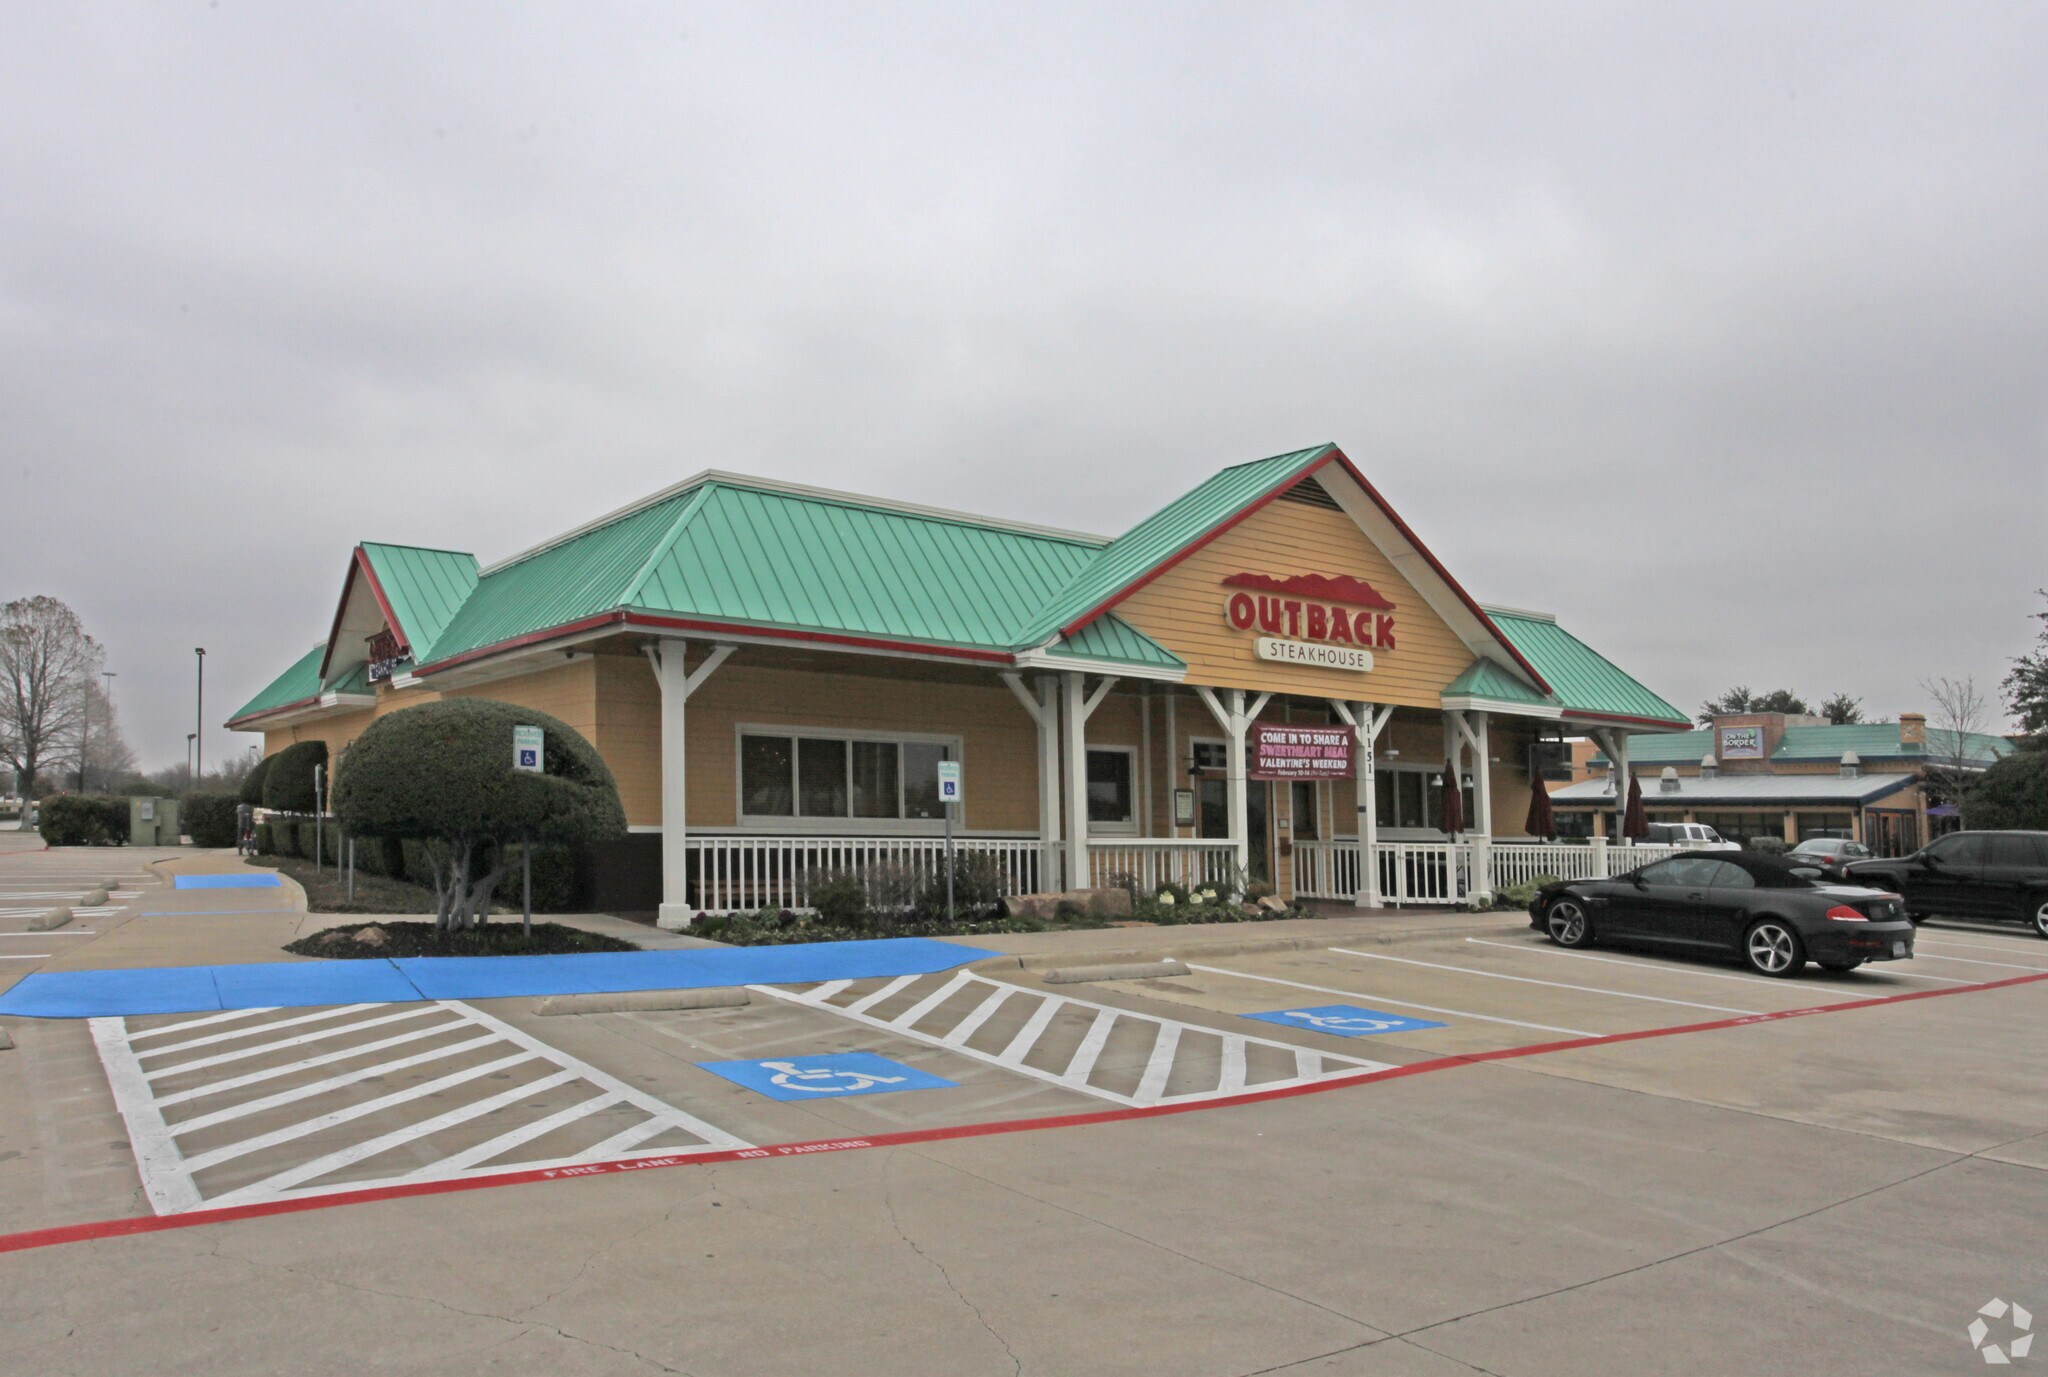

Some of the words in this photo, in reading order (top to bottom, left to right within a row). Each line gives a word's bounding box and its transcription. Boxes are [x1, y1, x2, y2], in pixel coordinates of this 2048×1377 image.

[1229, 592, 1396, 650] OUTBACK
[1270, 642, 1364, 667] STEAKHOUSE
[1260, 732, 1286, 743] COME
[1288, 733, 1298, 744] IN
[1299, 733, 1312, 744] TO
[1313, 734, 1340, 745] SHARE
[1341, 735, 1348, 746] A
[1723, 739, 1757, 748] BORDER
[1260, 744, 1322, 758] SWEETHEART
[1323, 746, 1348, 758] MEAL
[1260, 758, 1310, 768] VALENTINE'S
[1312, 759, 1347, 769] WEEKEND
[736, 1149, 770, 1159] NO
[778, 1140, 872, 1155] PARKING
[543, 1165, 606, 1178] FIRE
[616, 1157, 684, 1170] LANE
